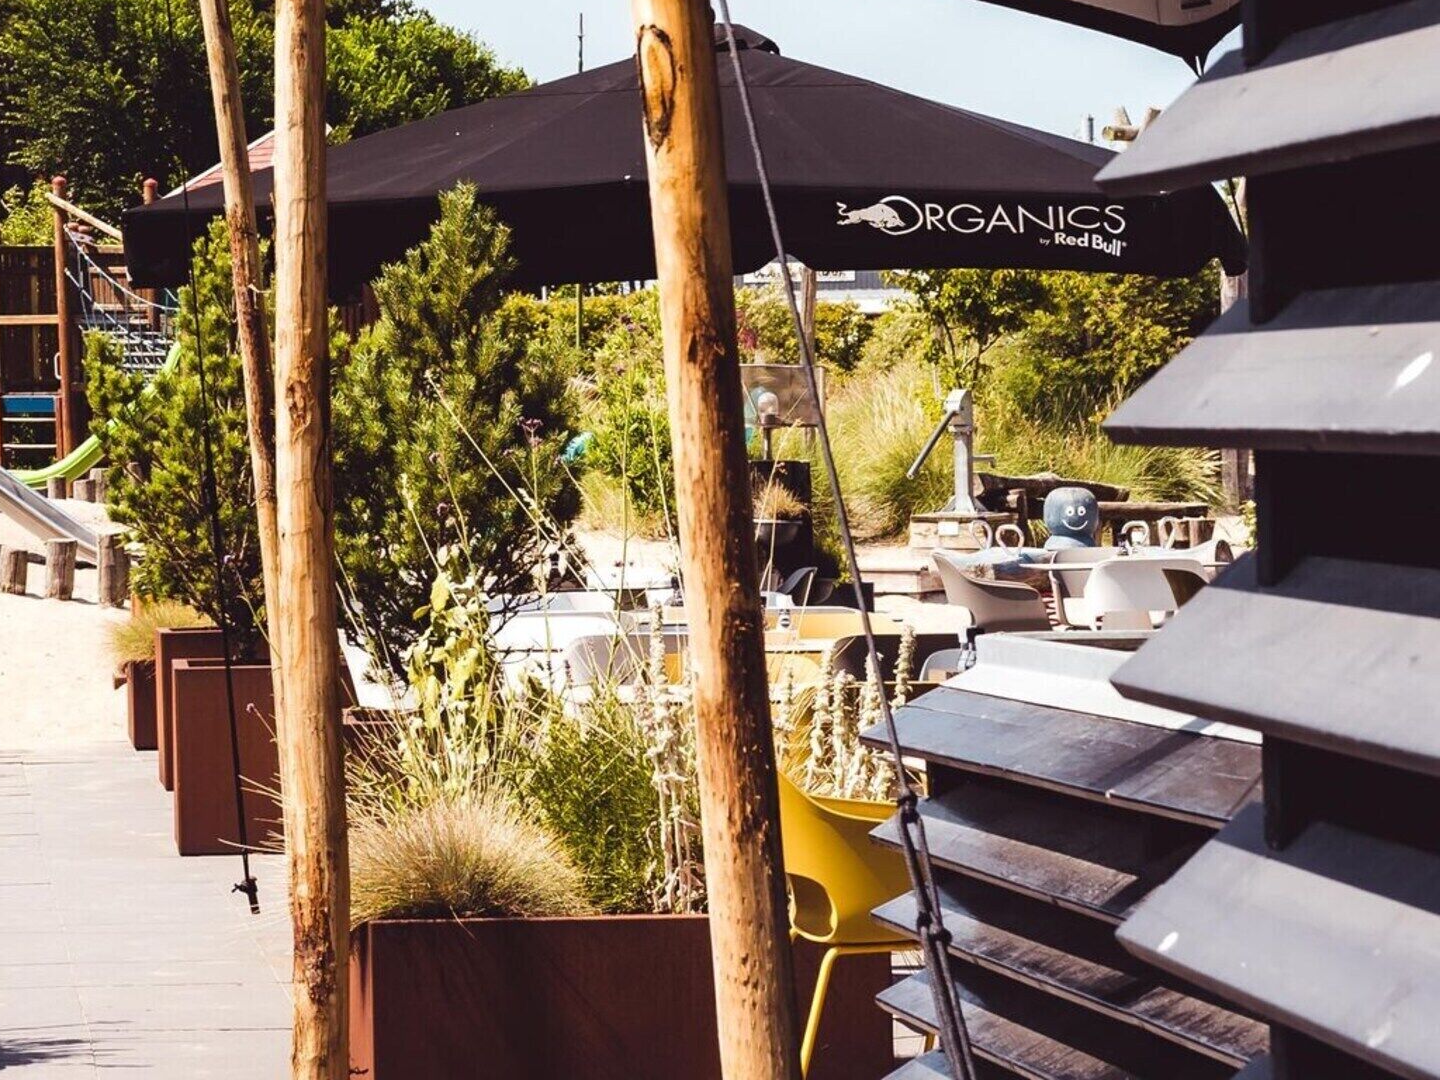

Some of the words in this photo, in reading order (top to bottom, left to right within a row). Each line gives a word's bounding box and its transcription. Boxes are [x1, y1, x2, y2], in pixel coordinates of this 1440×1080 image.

[879, 195, 1126, 235] ORGANICS
[1039, 238, 1051, 247] by
[1054, 232, 1089, 247] Red
